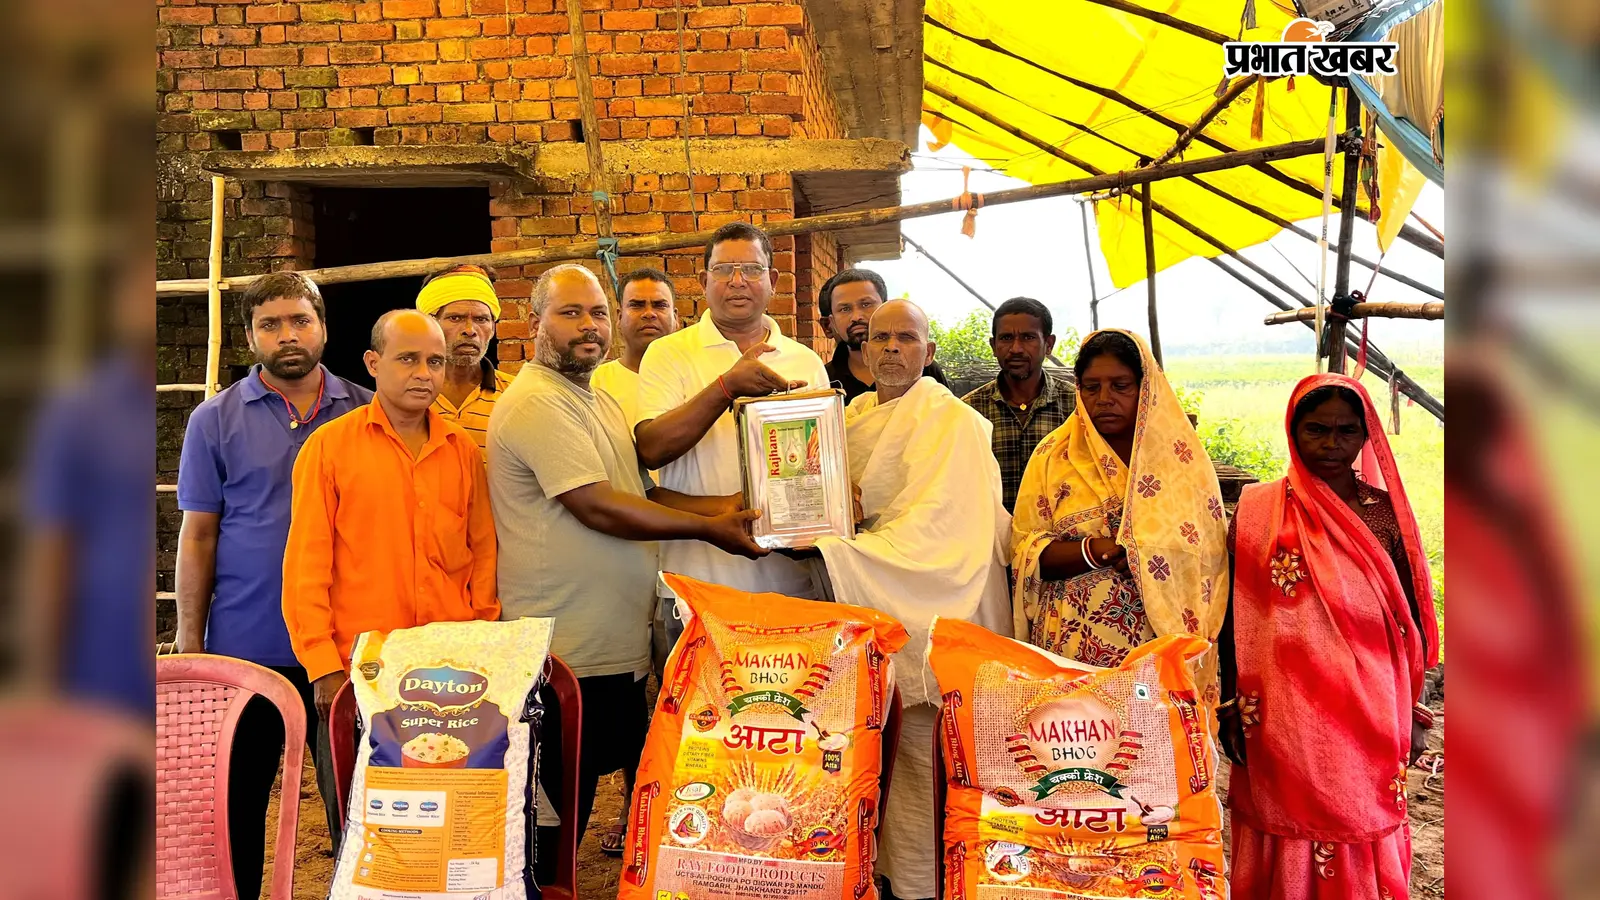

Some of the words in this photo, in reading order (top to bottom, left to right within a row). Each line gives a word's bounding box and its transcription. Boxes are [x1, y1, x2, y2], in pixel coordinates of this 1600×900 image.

[769, 429, 781, 476] Rajhans
[734, 652, 809, 670] MAKHAN
[404, 678, 483, 694] Dayton
[750, 672, 788, 684] BHOG
[743, 691, 771, 704] चक्की
[401, 717, 443, 728] Super
[447, 718, 479, 728] Rice
[1029, 719, 1116, 743] MAKHAN
[724, 724, 806, 755] आटा
[825, 753, 840, 762] 100%
[1052, 746, 1096, 761] BHOG
[1049, 769, 1081, 784] चक्की
[1084, 769, 1104, 785] फ्रेश
[639, 791, 648, 824] Makhan
[1035, 807, 1127, 832] आटा
[636, 827, 645, 847] Bhog
[677, 858, 701, 871] RAY
[708, 862, 745, 877] FOOD
[750, 867, 826, 882] PRODUCTS
[735, 885, 781, 895] JHARKHAND
